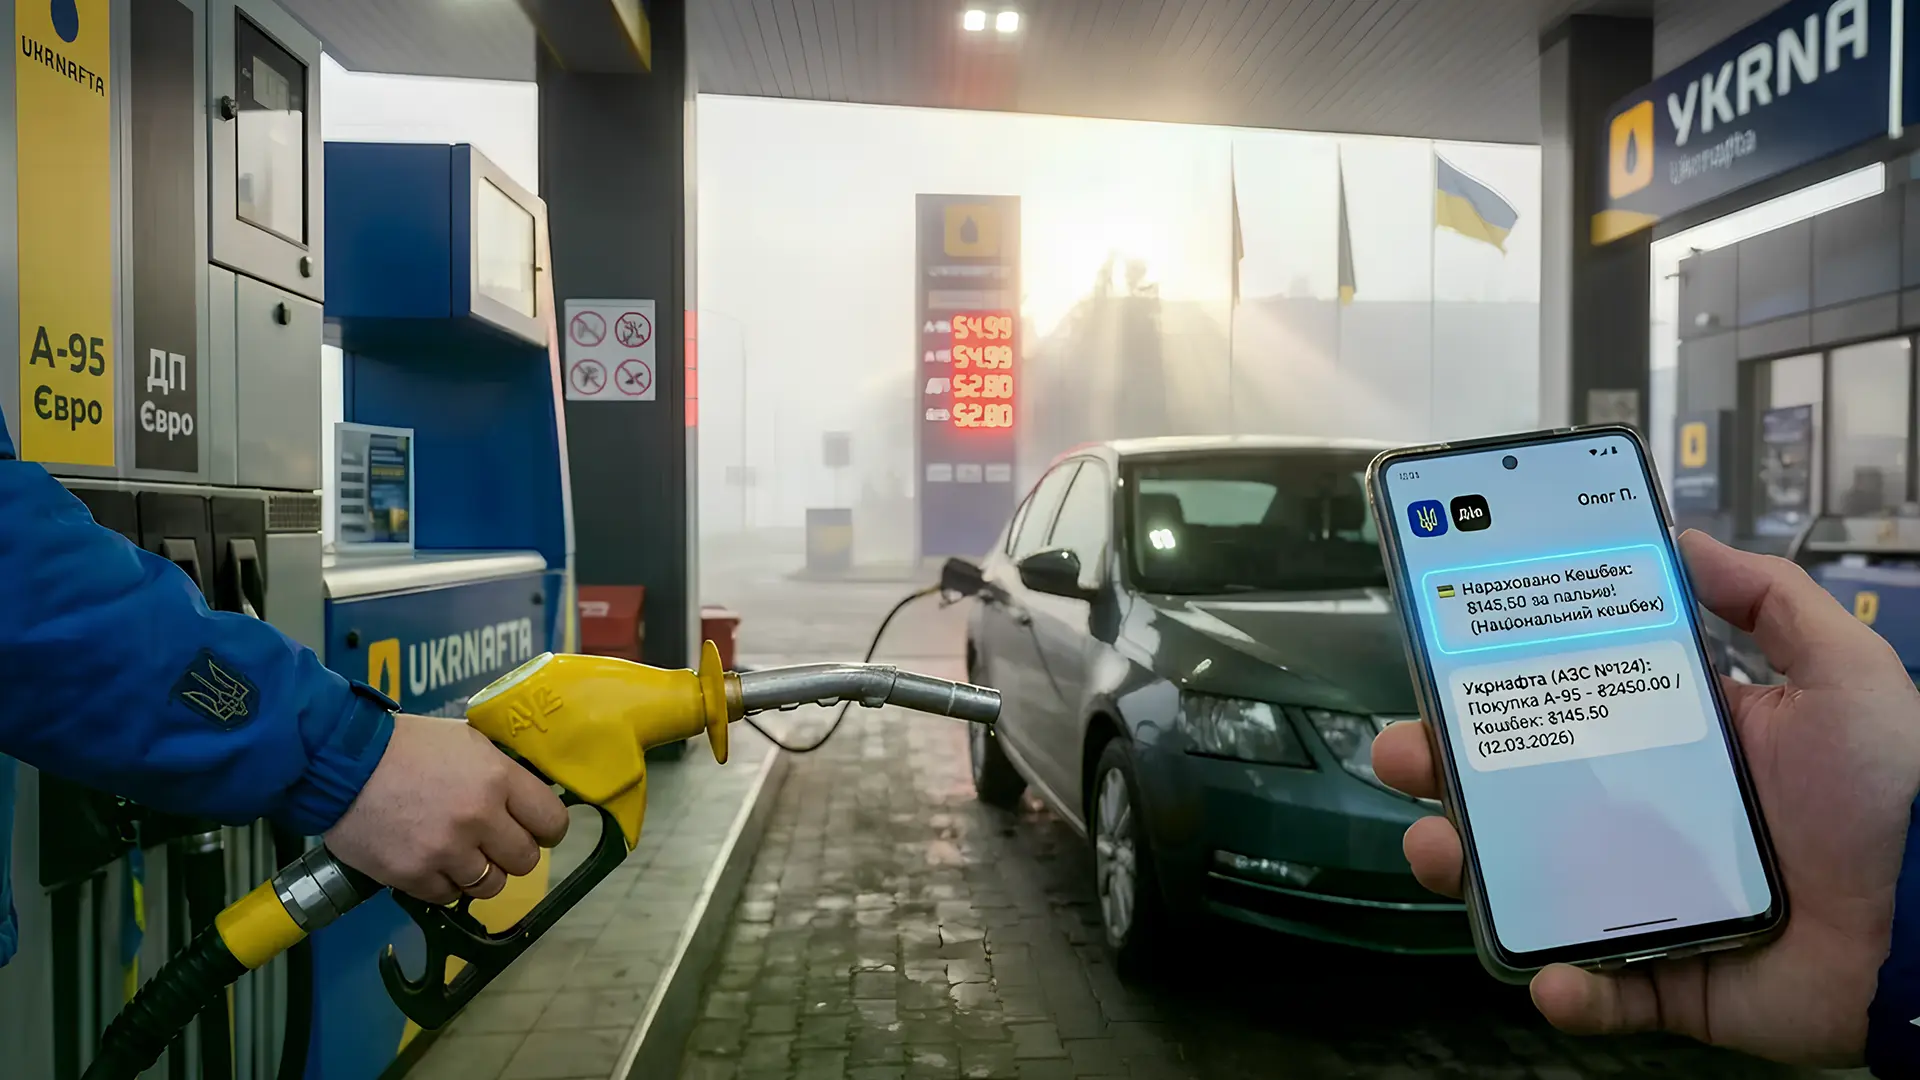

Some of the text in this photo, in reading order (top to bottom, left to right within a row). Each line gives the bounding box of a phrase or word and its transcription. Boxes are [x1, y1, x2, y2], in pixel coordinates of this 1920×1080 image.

[21, 35, 105, 97] UKRNAFTA
[29, 325, 105, 377] А-95
[146, 348, 187, 396] ДП
[34, 384, 103, 432] Євро
[140, 400, 194, 441] Євро
[1462, 572, 1561, 596] Нараховано
[409, 616, 533, 697] UKRNAFTA
[1462, 673, 1548, 697] Укрнафта
[1551, 665, 1591, 686] (АЗС
[1468, 694, 1539, 716] Покупка
[1544, 688, 1582, 706] А-95
[1478, 729, 1576, 758] (12.03.2026)
